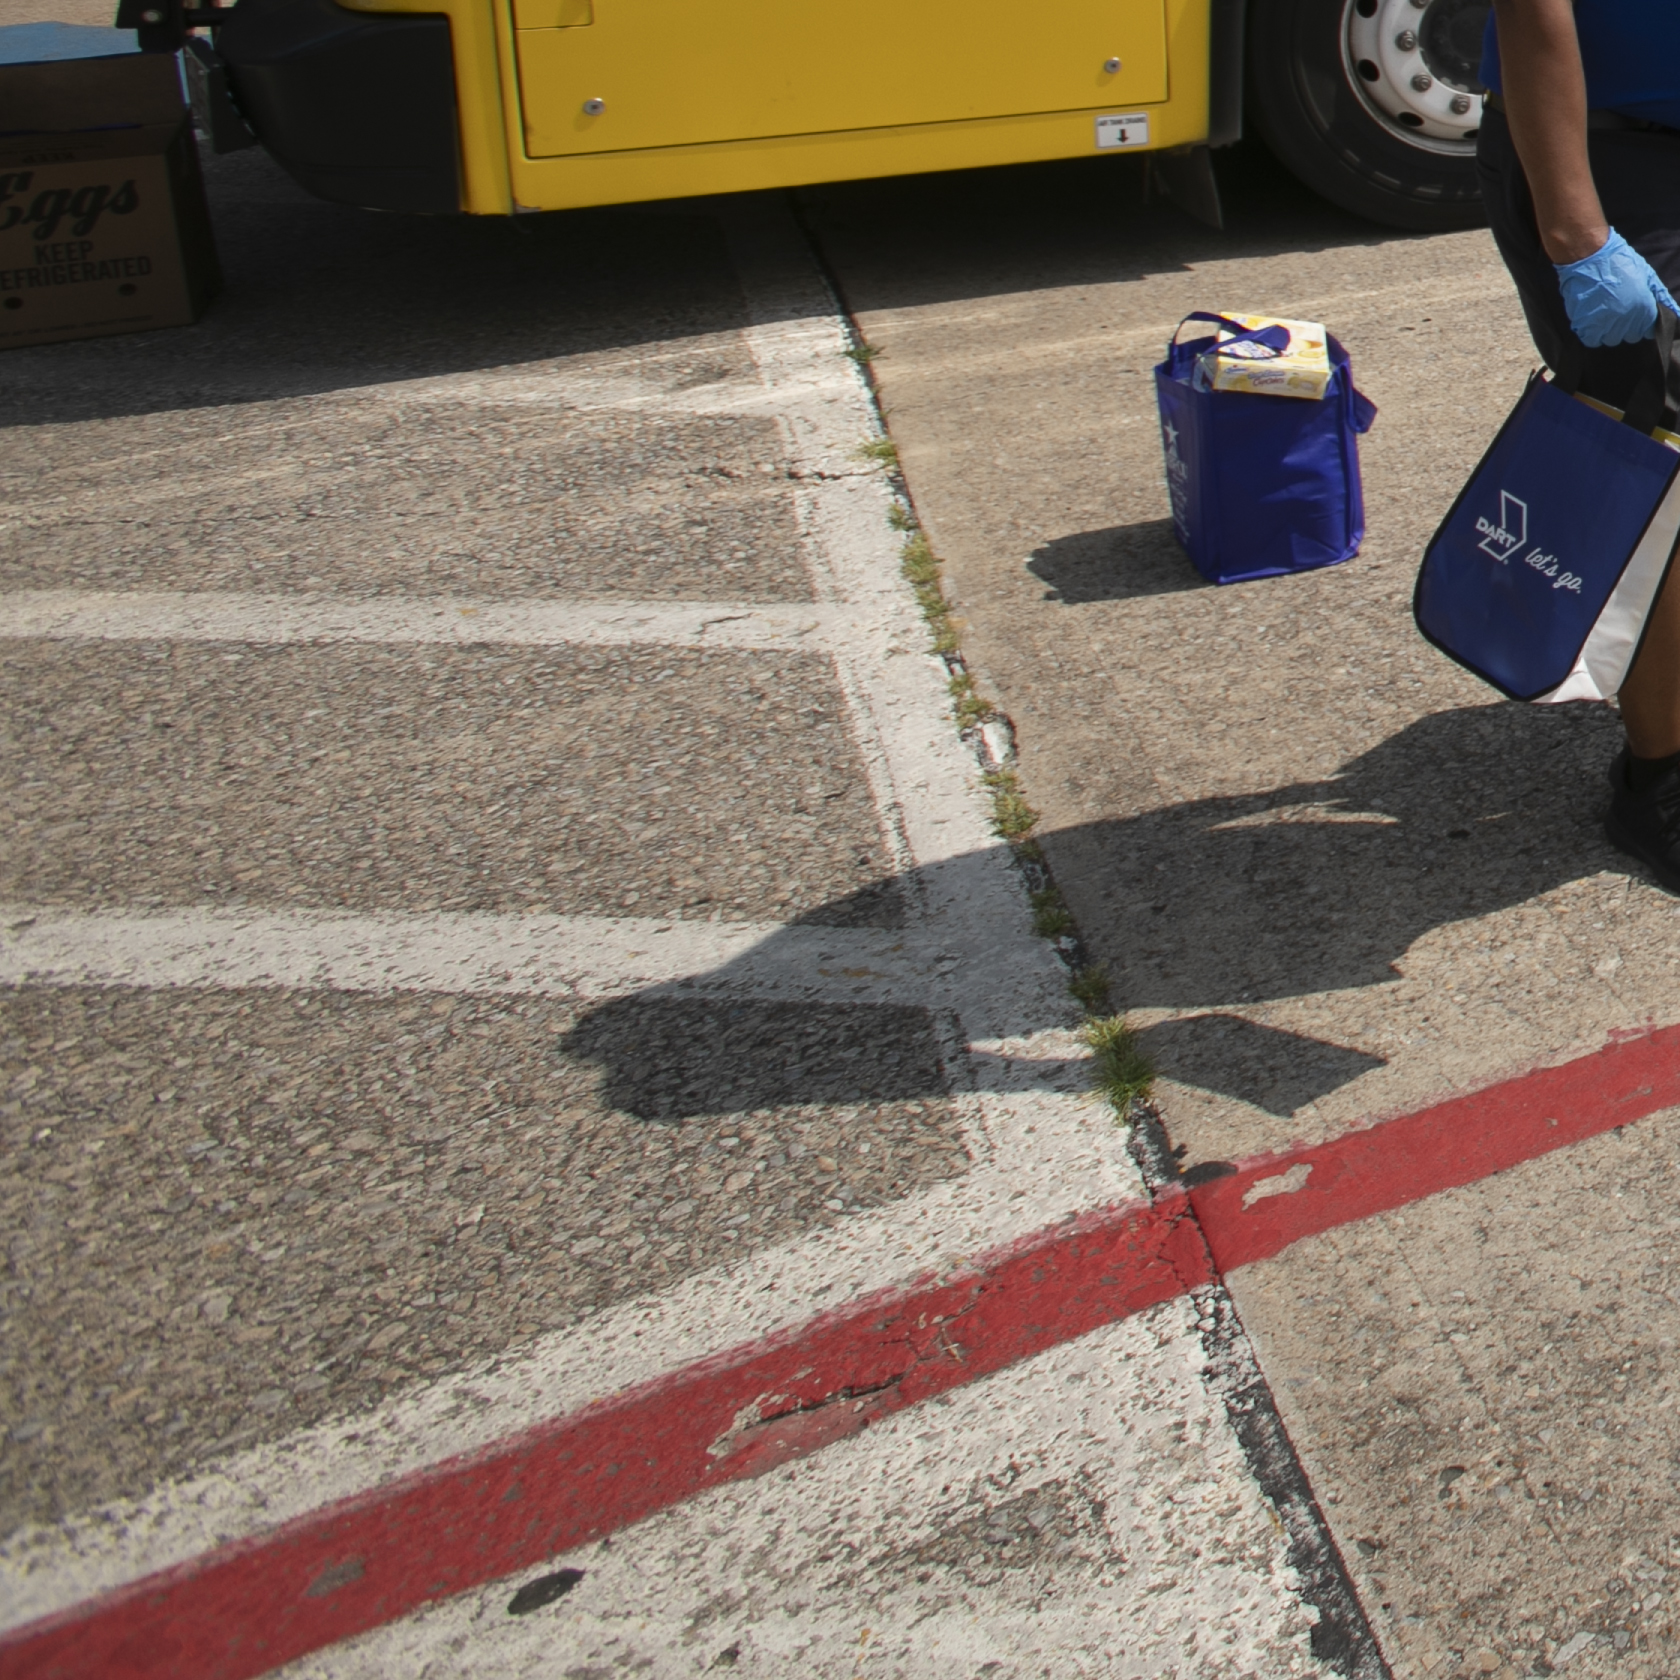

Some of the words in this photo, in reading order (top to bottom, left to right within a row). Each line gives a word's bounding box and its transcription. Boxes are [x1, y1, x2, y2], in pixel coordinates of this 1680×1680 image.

[34, 240, 95, 266] KEEP
[0, 255, 153, 292] EFRIGERATED
[1476, 516, 1516, 548] DART
[1525, 547, 1559, 577] let's
[1552, 572, 1582, 594] go.
